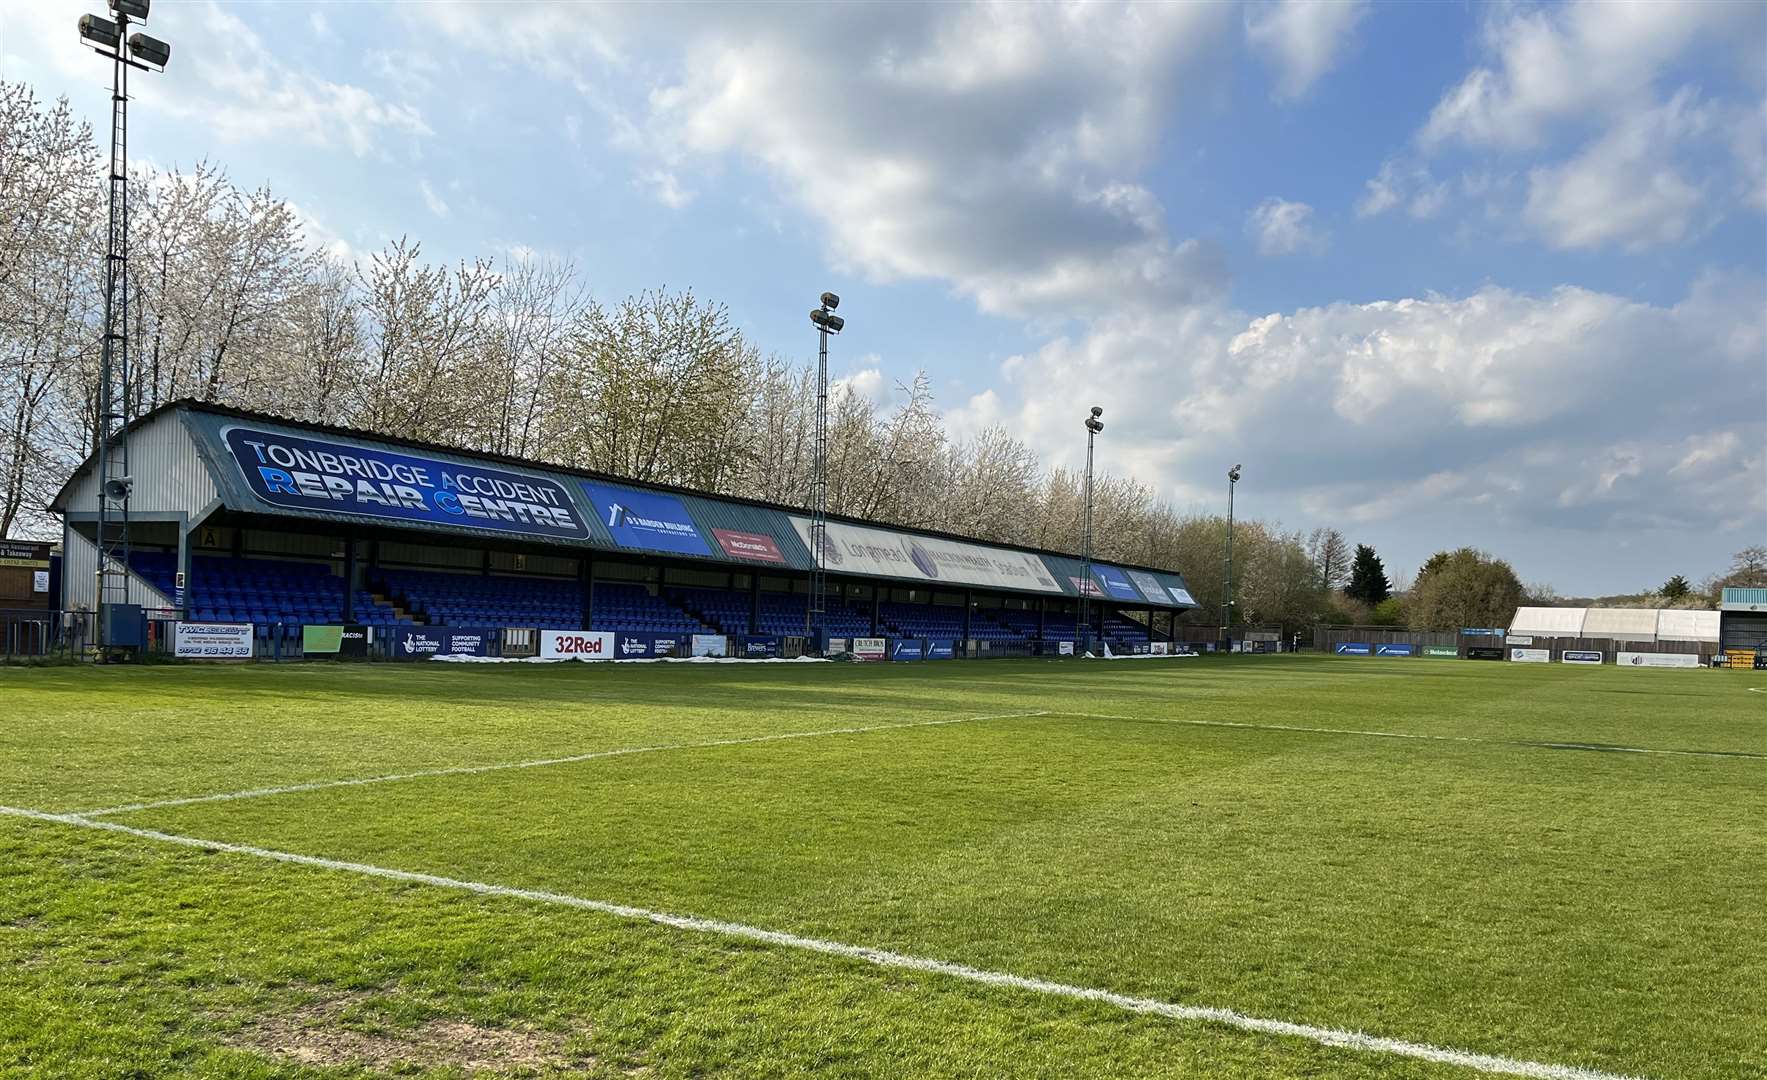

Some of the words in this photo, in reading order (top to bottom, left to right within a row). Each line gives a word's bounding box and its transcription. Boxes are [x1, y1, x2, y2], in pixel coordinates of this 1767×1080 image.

[244, 440, 435, 489] TONBRIDGE
[441, 472, 557, 507] ACCIDENT
[257, 466, 428, 511] REPAIR
[433, 491, 578, 530] CENTRE
[663, 521, 694, 533] BUILDING
[204, 532, 216, 546] A
[841, 539, 907, 564] Longmead
[554, 635, 602, 653] 32Red
